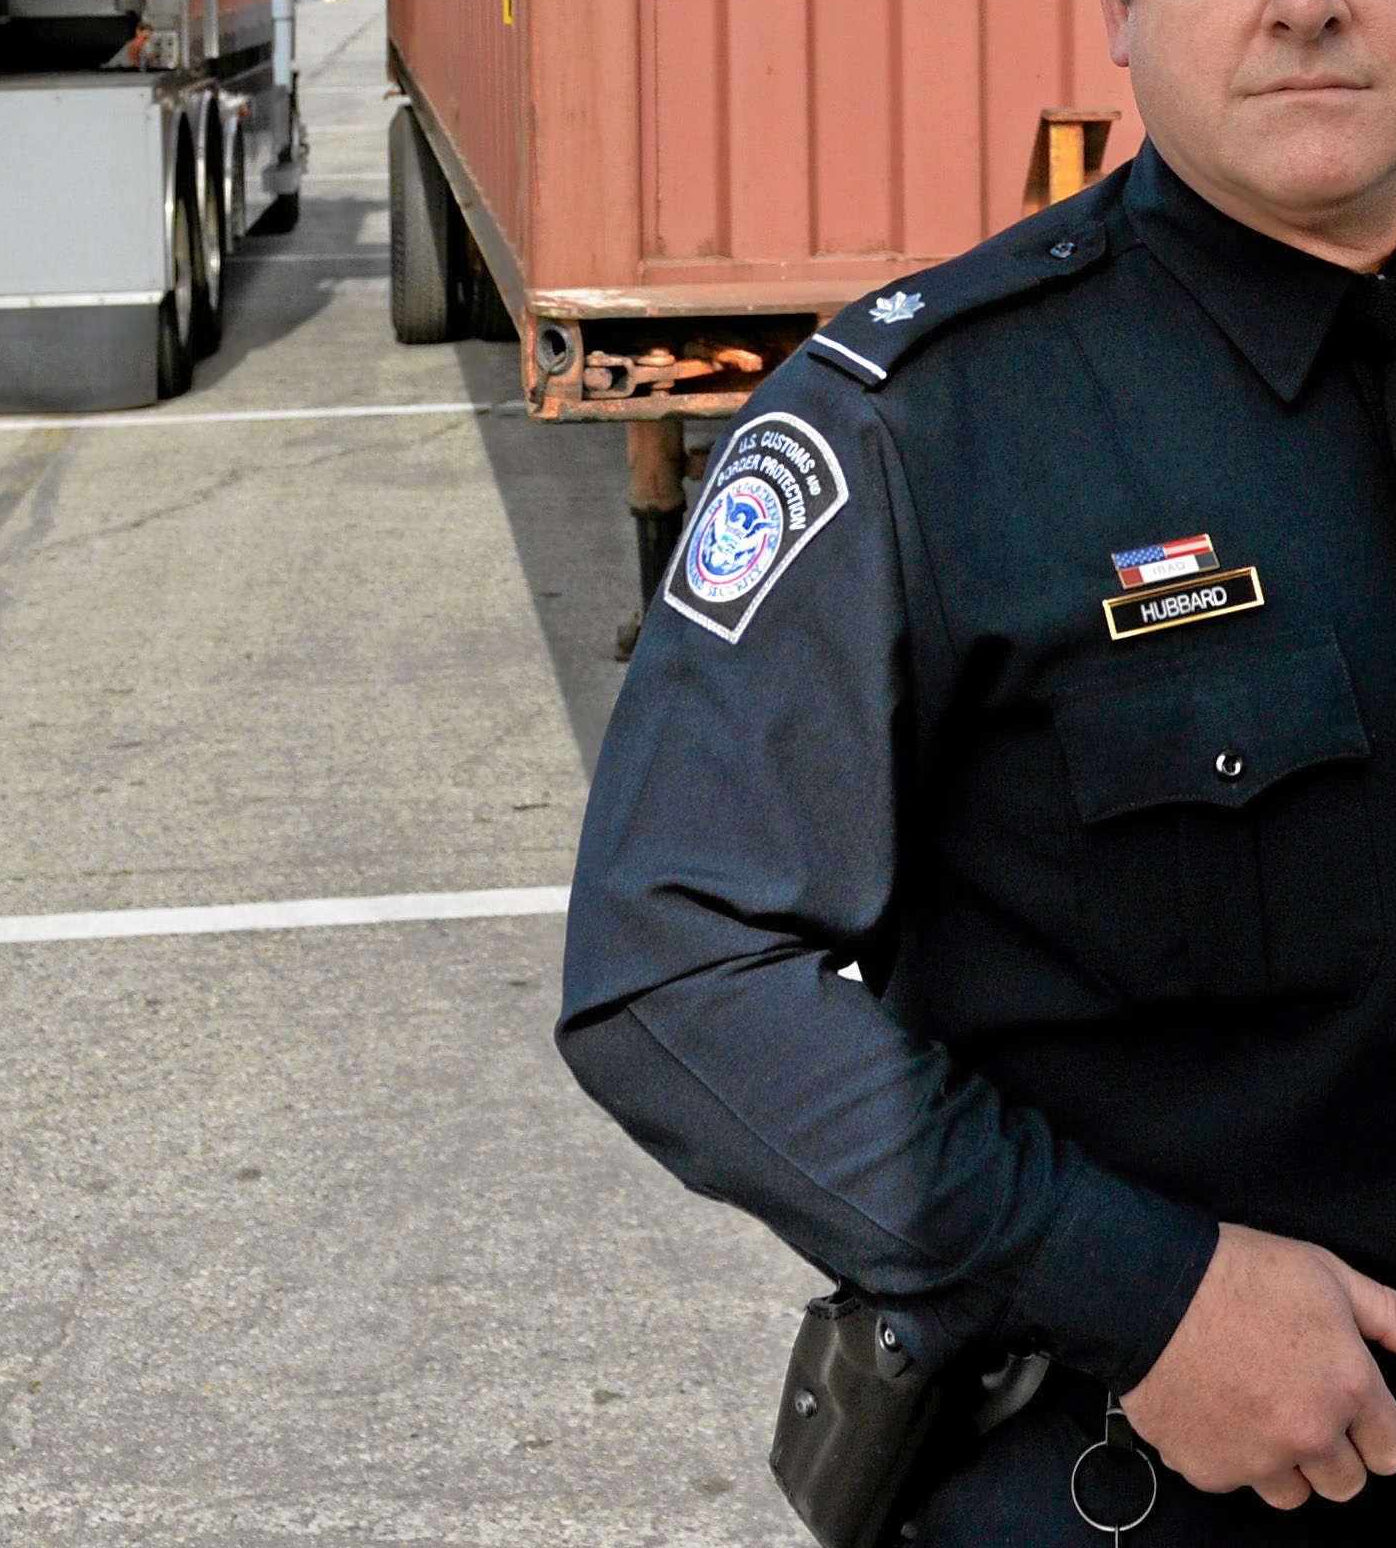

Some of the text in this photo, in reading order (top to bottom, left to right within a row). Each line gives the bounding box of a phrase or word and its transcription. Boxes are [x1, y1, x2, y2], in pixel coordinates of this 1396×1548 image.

[760, 430, 816, 474] CUSTOMS
[717, 454, 806, 531] BORDER PROTECTION
[1140, 585, 1228, 624] HUBBARD
